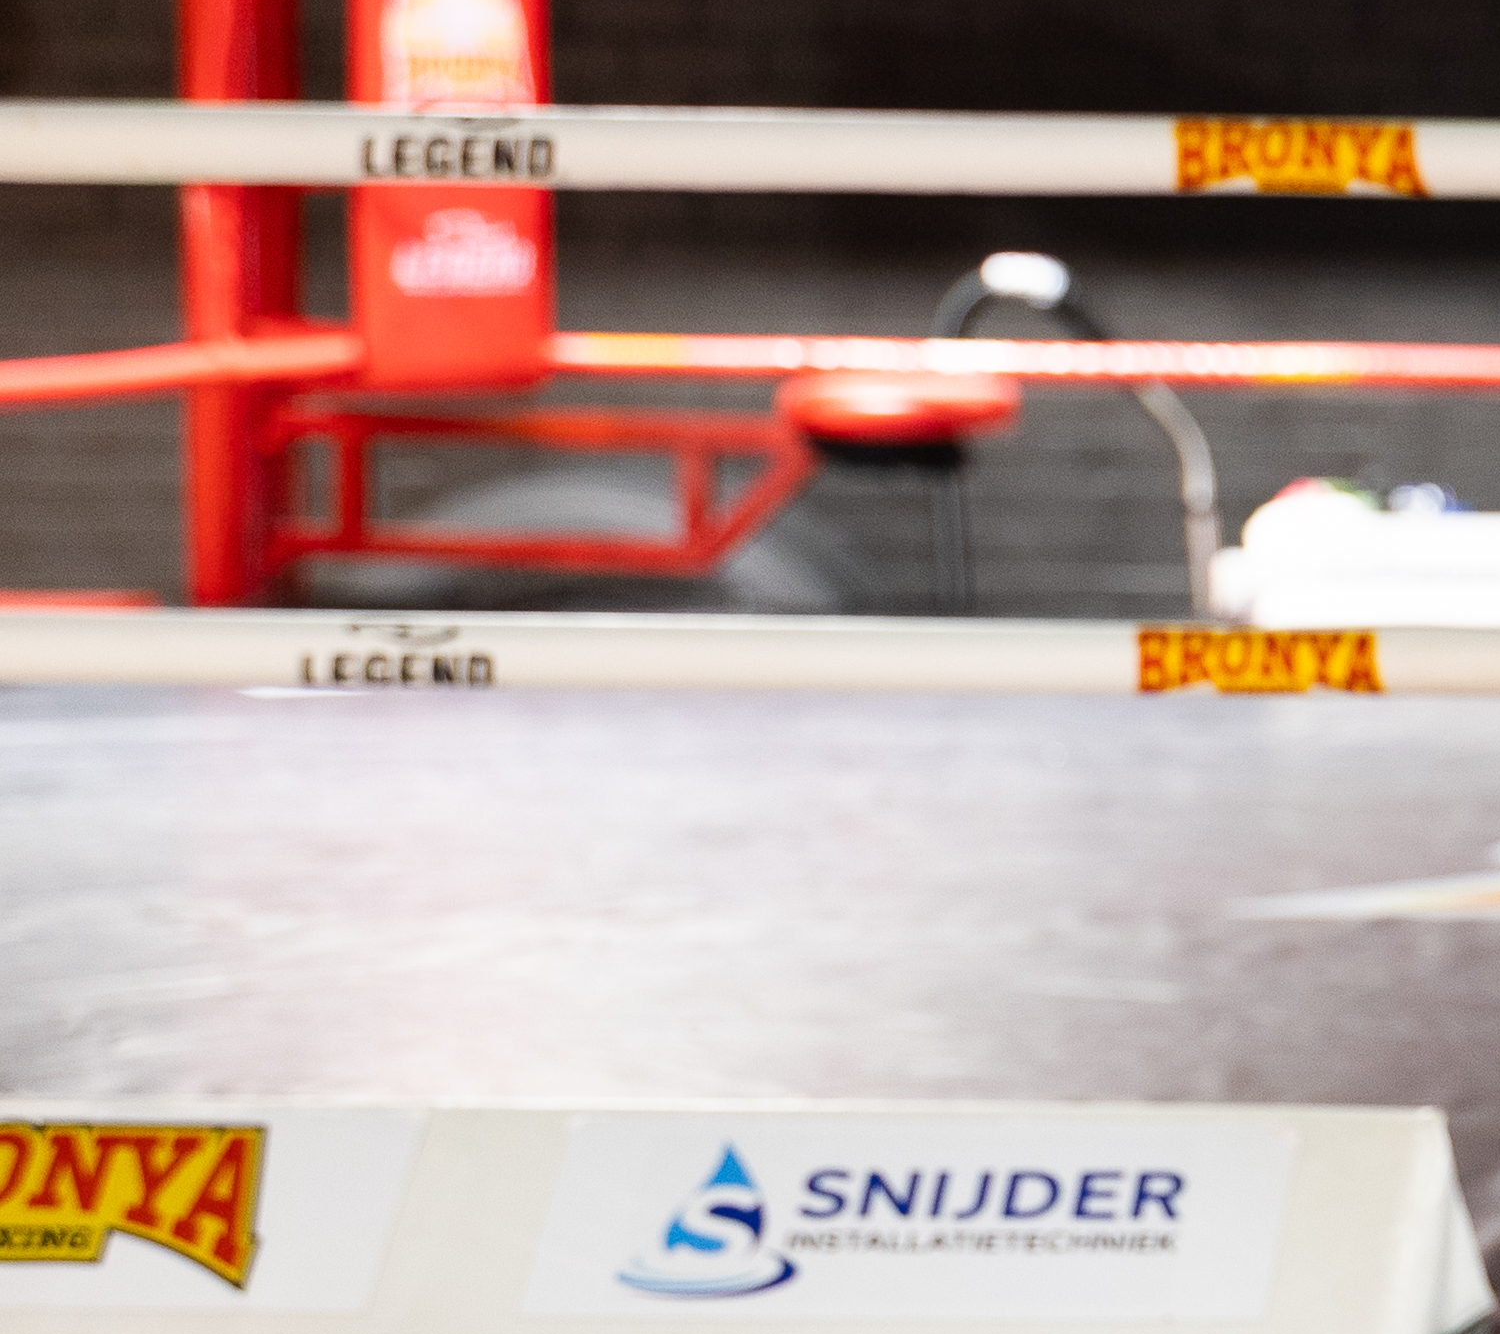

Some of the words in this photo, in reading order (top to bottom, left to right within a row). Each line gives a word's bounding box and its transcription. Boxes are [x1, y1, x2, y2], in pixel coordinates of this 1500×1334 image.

[361, 137, 556, 177] LEGEND
[1175, 121, 1428, 193] BRONYA
[303, 650, 493, 685] LEGEND
[1139, 630, 1383, 693] BRONYA
[799, 1168, 1185, 1221] SNIJDER
